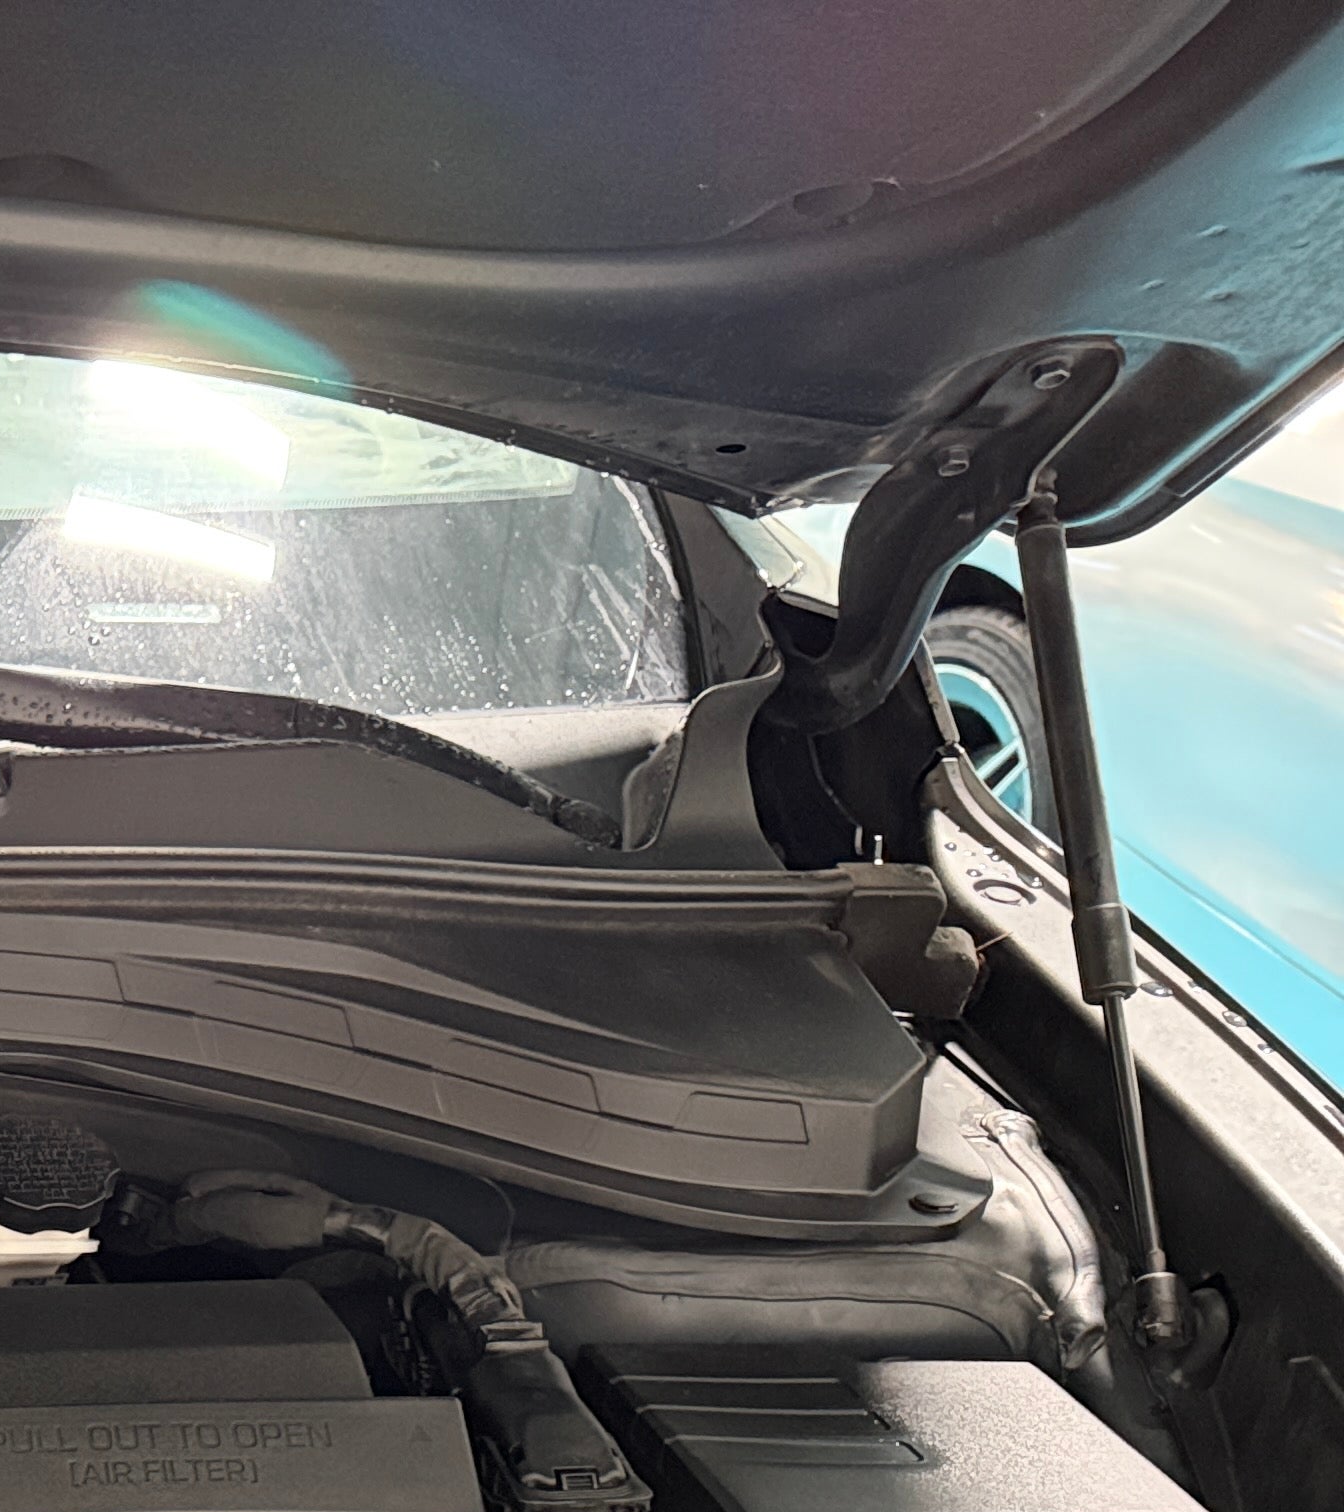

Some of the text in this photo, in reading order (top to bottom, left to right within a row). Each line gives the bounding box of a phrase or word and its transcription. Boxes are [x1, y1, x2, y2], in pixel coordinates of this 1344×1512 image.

[87, 1423, 161, 1451] OUT
[172, 1422, 222, 1450] TO
[232, 1421, 332, 1448] OPEN
[142, 1458, 259, 1483] FILTER]
